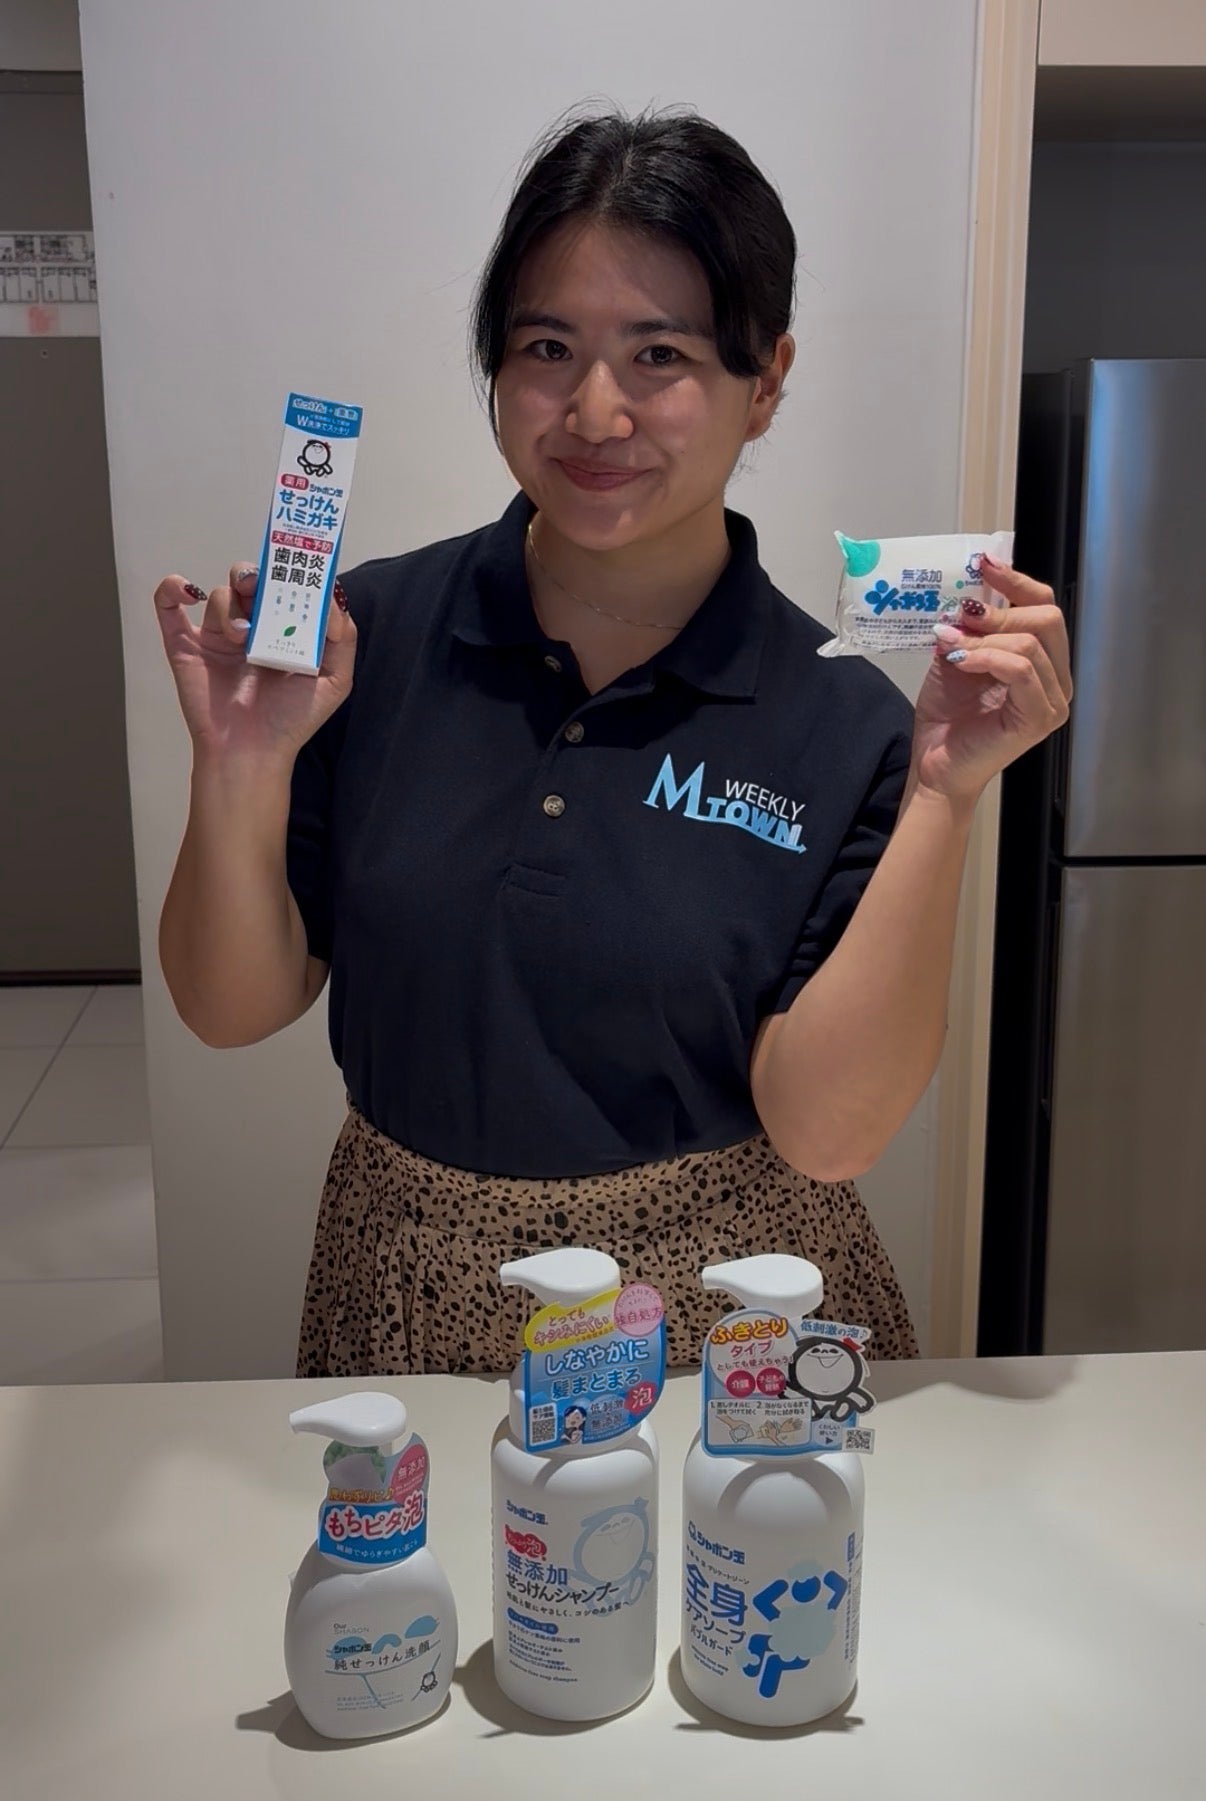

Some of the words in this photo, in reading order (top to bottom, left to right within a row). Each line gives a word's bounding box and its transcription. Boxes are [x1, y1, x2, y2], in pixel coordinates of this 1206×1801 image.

[285, 475, 306, 489] 薬用
[309, 484, 343, 498] シャボン玉
[279, 489, 339, 514] せっけん
[276, 506, 337, 531] ハミガキ
[273, 533, 333, 553] 天然塩で予防
[273, 547, 326, 572] 歯肉炎
[270, 564, 322, 590] 歯周炎
[902, 568, 942, 583] 無添加
[725, 778, 806, 822] WEEKLY
[549, 1307, 585, 1327] とっても
[710, 1317, 789, 1345] ふきとり
[545, 1339, 649, 1376] しなやかに
[730, 1341, 773, 1358] タイプ
[551, 1367, 642, 1400] 髪まとまる
[631, 1387, 653, 1409] 泡
[326, 1491, 425, 1540] もちピタ泡
[507, 1500, 547, 1525] シャボン玉
[697, 1530, 745, 1566] シャボン玉
[507, 1550, 568, 1586] 無添加
[506, 1572, 619, 1605] せっけんシャンプー
[686, 1562, 748, 1627] 全身
[686, 1599, 746, 1644] ケアソープ
[334, 1643, 372, 1654] シャボン玉
[690, 1624, 733, 1656] バブルガード
[334, 1640, 431, 1671] 純せっけん洗顔
